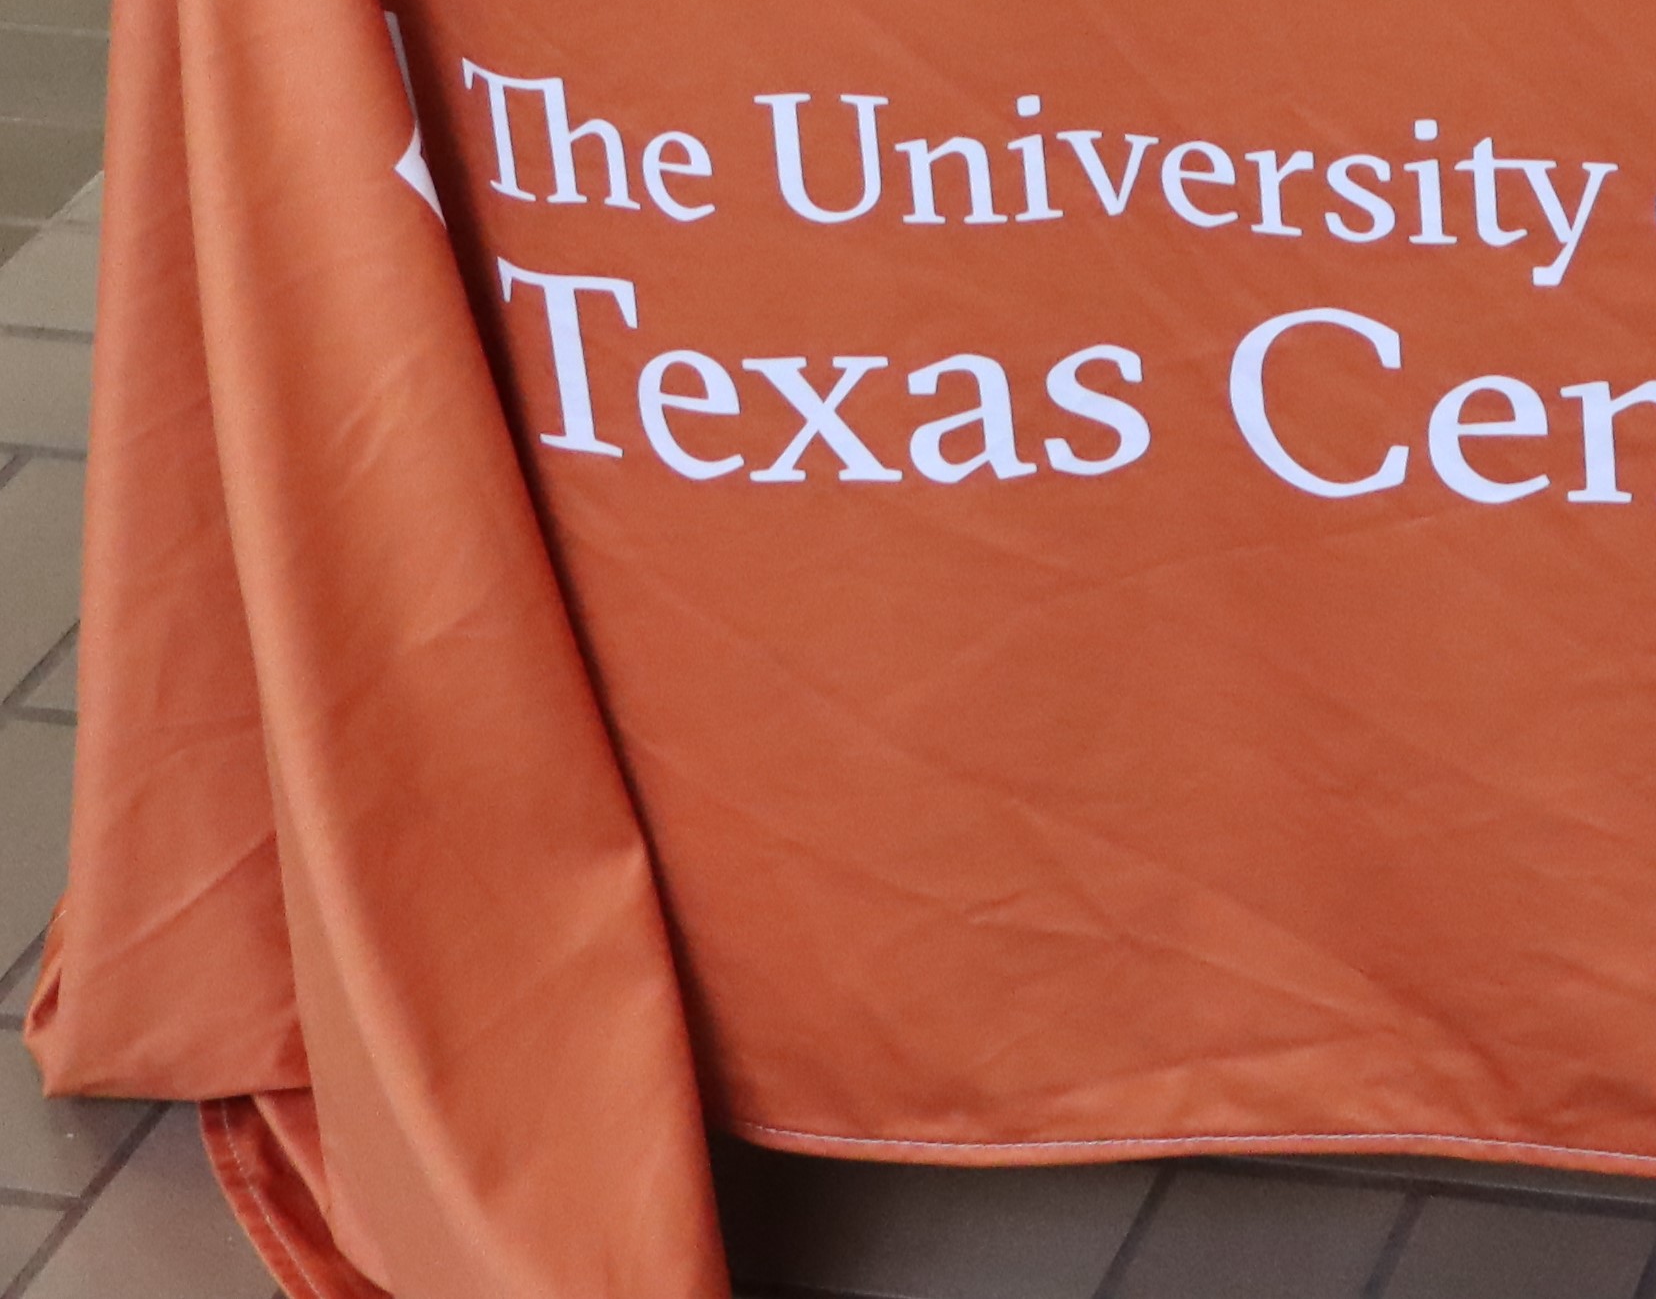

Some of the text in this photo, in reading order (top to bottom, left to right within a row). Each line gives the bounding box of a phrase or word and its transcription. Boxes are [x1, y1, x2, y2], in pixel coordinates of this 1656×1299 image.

[463, 56, 715, 222] The
[755, 90, 1617, 287] University
[498, 256, 1152, 485] Texas
